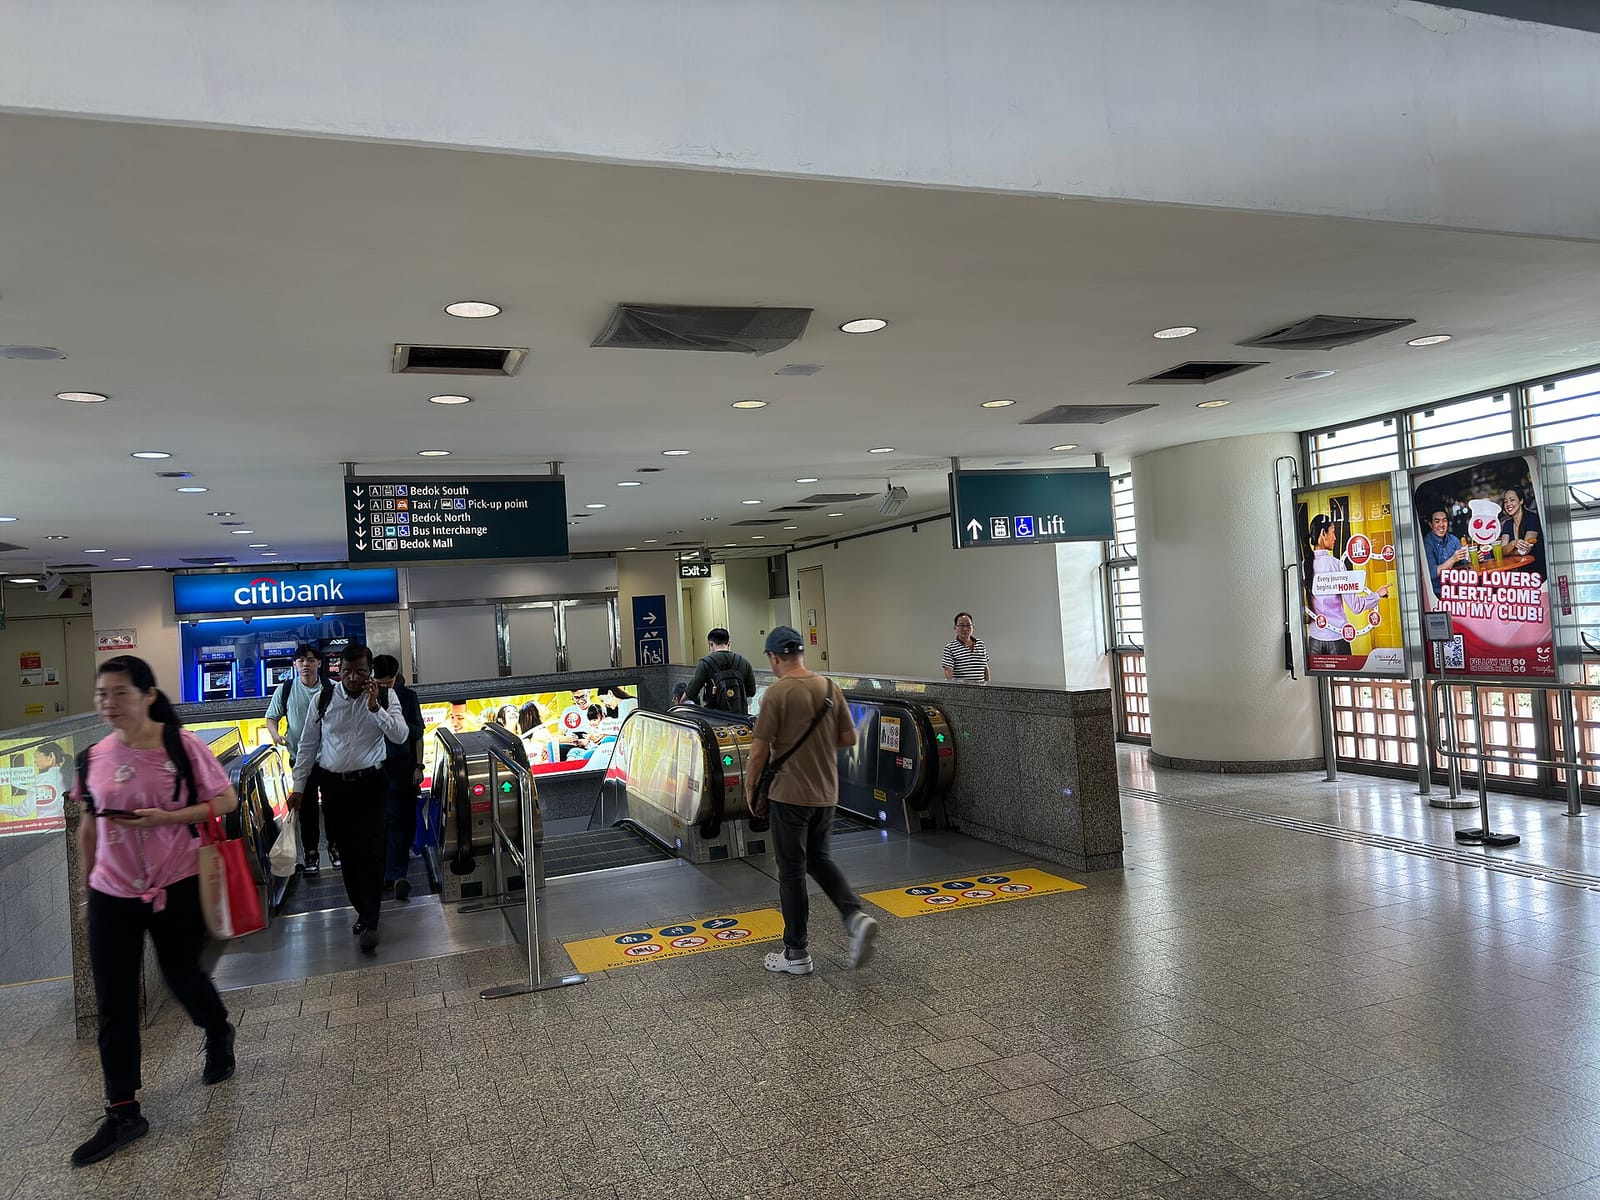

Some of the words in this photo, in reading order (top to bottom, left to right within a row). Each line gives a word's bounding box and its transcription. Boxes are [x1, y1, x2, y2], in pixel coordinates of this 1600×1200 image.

[410, 487, 440, 496] Bedok
[442, 486, 470, 496] South
[412, 500, 432, 510] Taxi
[468, 500, 502, 511] Pick-up
[504, 500, 529, 511] point
[412, 513, 442, 523] Bedok
[444, 512, 471, 522] North
[1038, 515, 1066, 535] Lift
[413, 526, 430, 536] Bus
[432, 526, 488, 537] Interchange
[400, 539, 431, 549] Bedok
[433, 538, 453, 548] Mall
[682, 565, 700, 577] Exit
[1317, 575, 1330, 583] Every
[1330, 574, 1348, 583] journey
[1441, 569, 1478, 585] FOOD
[1482, 571, 1542, 588] LOVERS
[234, 577, 344, 605] citibank
[1316, 583, 1331, 591] begins
[1338, 582, 1360, 591] HOME
[1441, 585, 1493, 602] ALERT!
[1497, 587, 1541, 605] COME
[1434, 599, 1466, 616] JOIN
[1470, 603, 1494, 618] MY
[1498, 604, 1543, 622] CLUB!
[625, 956, 650, 964] Your
[688, 945, 712, 954] Hold
[741, 933, 783, 943] Handrail
